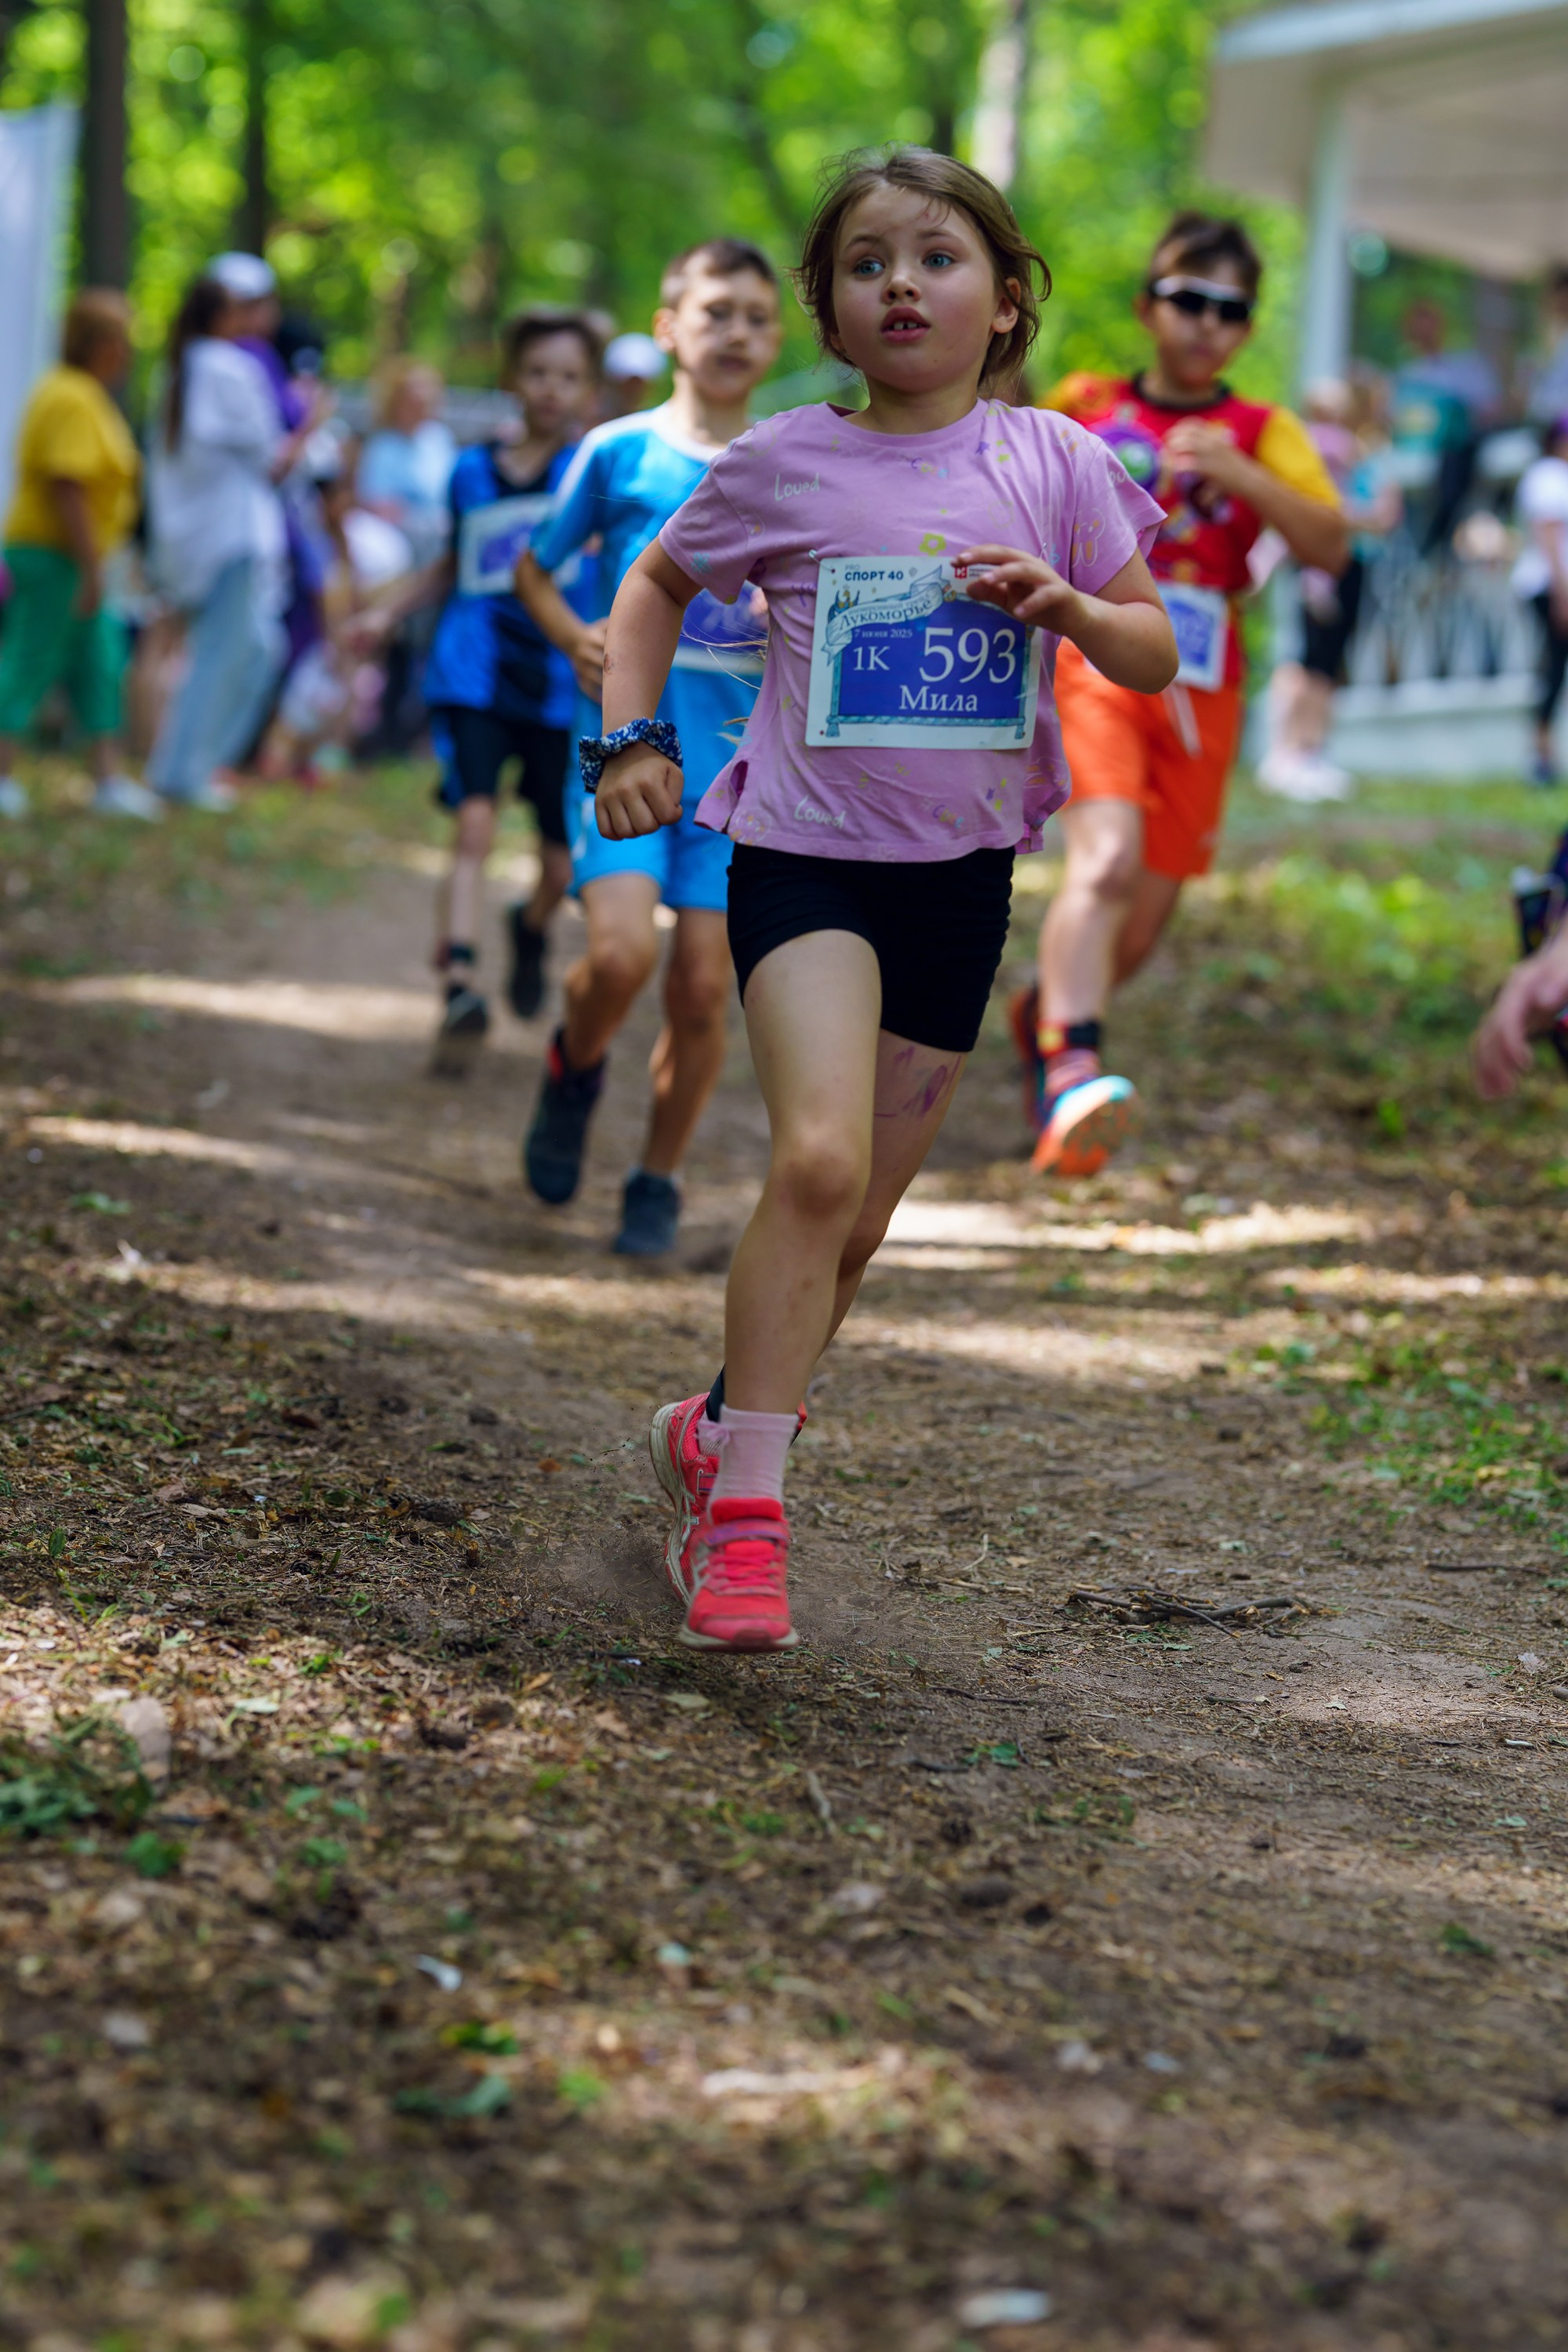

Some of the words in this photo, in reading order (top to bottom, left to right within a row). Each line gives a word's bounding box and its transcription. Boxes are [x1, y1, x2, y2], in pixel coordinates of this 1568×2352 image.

[775, 473, 820, 501] Loved
[844, 571, 886, 581] СПОРТ
[887, 571, 904, 580] 40
[839, 600, 933, 630] Лукоморье
[855, 630, 861, 638] 7
[890, 630, 913, 638] 2025
[918, 626, 1016, 684] 593
[898, 684, 978, 712] Мила
[794, 796, 846, 829] Loved
